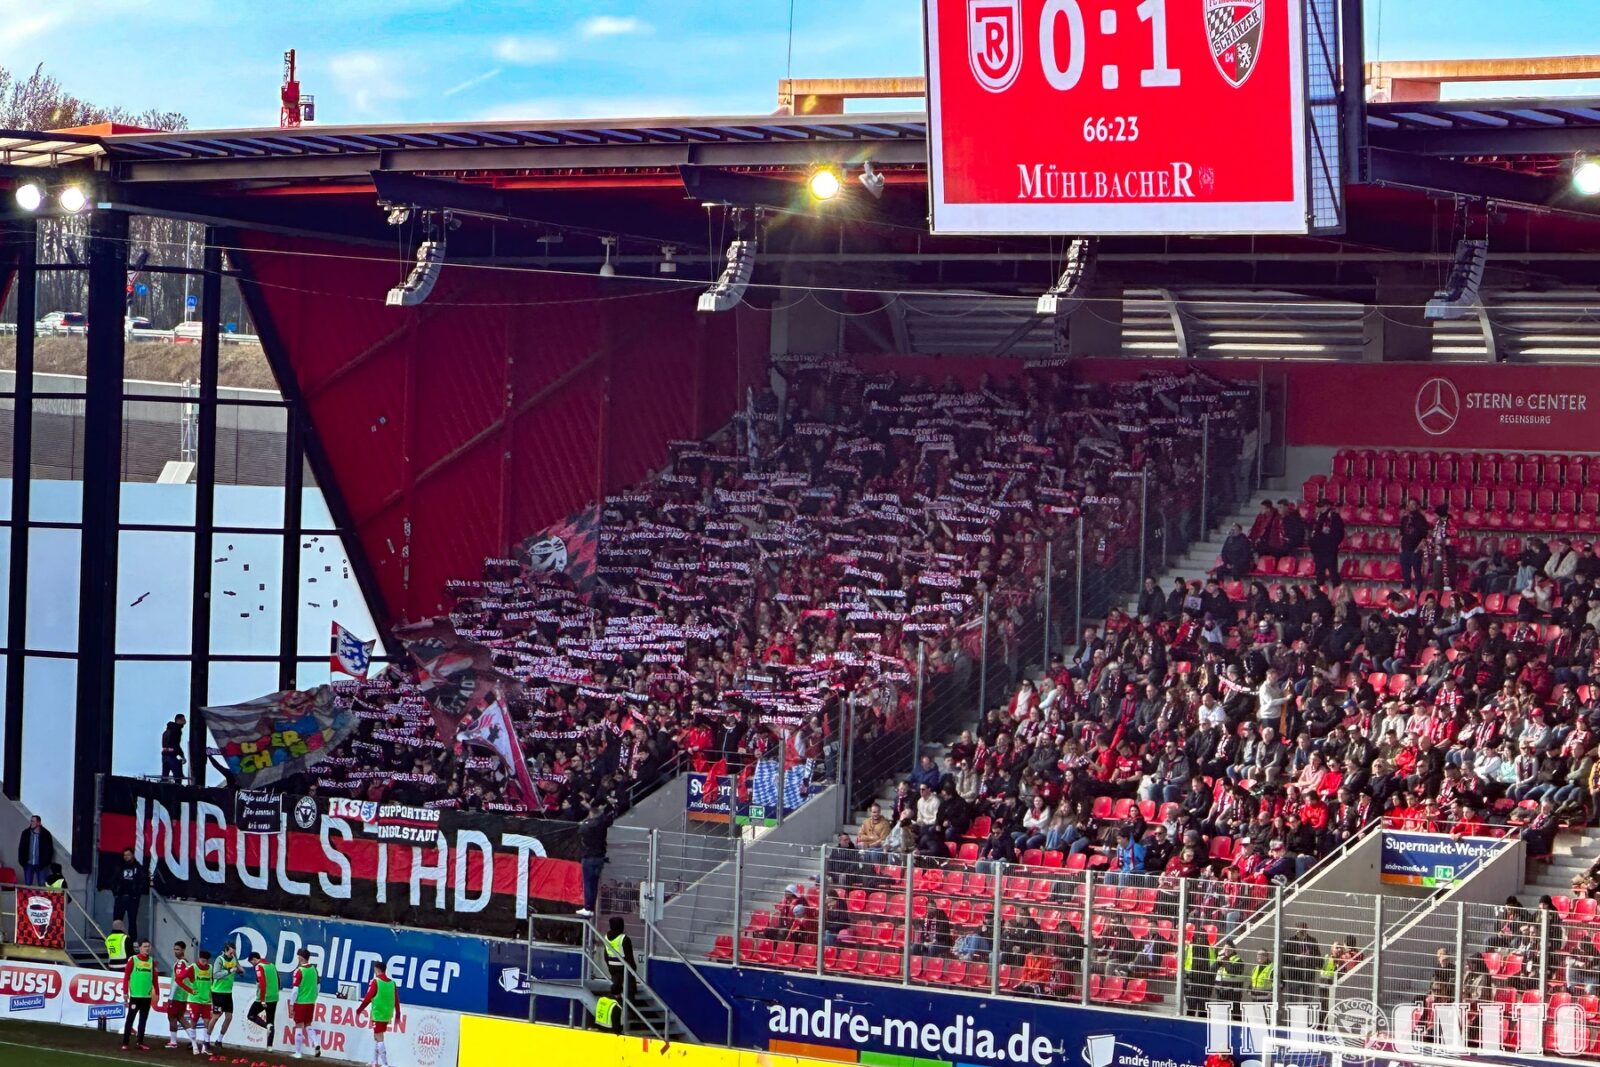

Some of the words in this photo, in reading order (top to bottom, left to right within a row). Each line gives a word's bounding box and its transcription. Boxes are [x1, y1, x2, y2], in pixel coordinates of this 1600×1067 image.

[1213, 10, 1260, 54] SCHANZER
[1083, 117, 1139, 142] 66:23
[1017, 162, 1195, 199] MÜHLBACHER
[1466, 393, 1512, 409] STERN
[1527, 394, 1587, 410] CENTER
[1500, 414, 1551, 424] REGENSBURG
[329, 797, 362, 816] FKS
[379, 804, 440, 822] SUPPORTERS
[378, 825, 438, 842] INGOLSTADT
[133, 796, 549, 919] INGOLSTADT
[0, 971, 57, 994] FUSSL
[76, 978, 125, 1001] FUSS
[418, 1035, 440, 1047] HAHN
[768, 999, 1053, 1064] andre-media.de
[1119, 1054, 1150, 1067] andré
